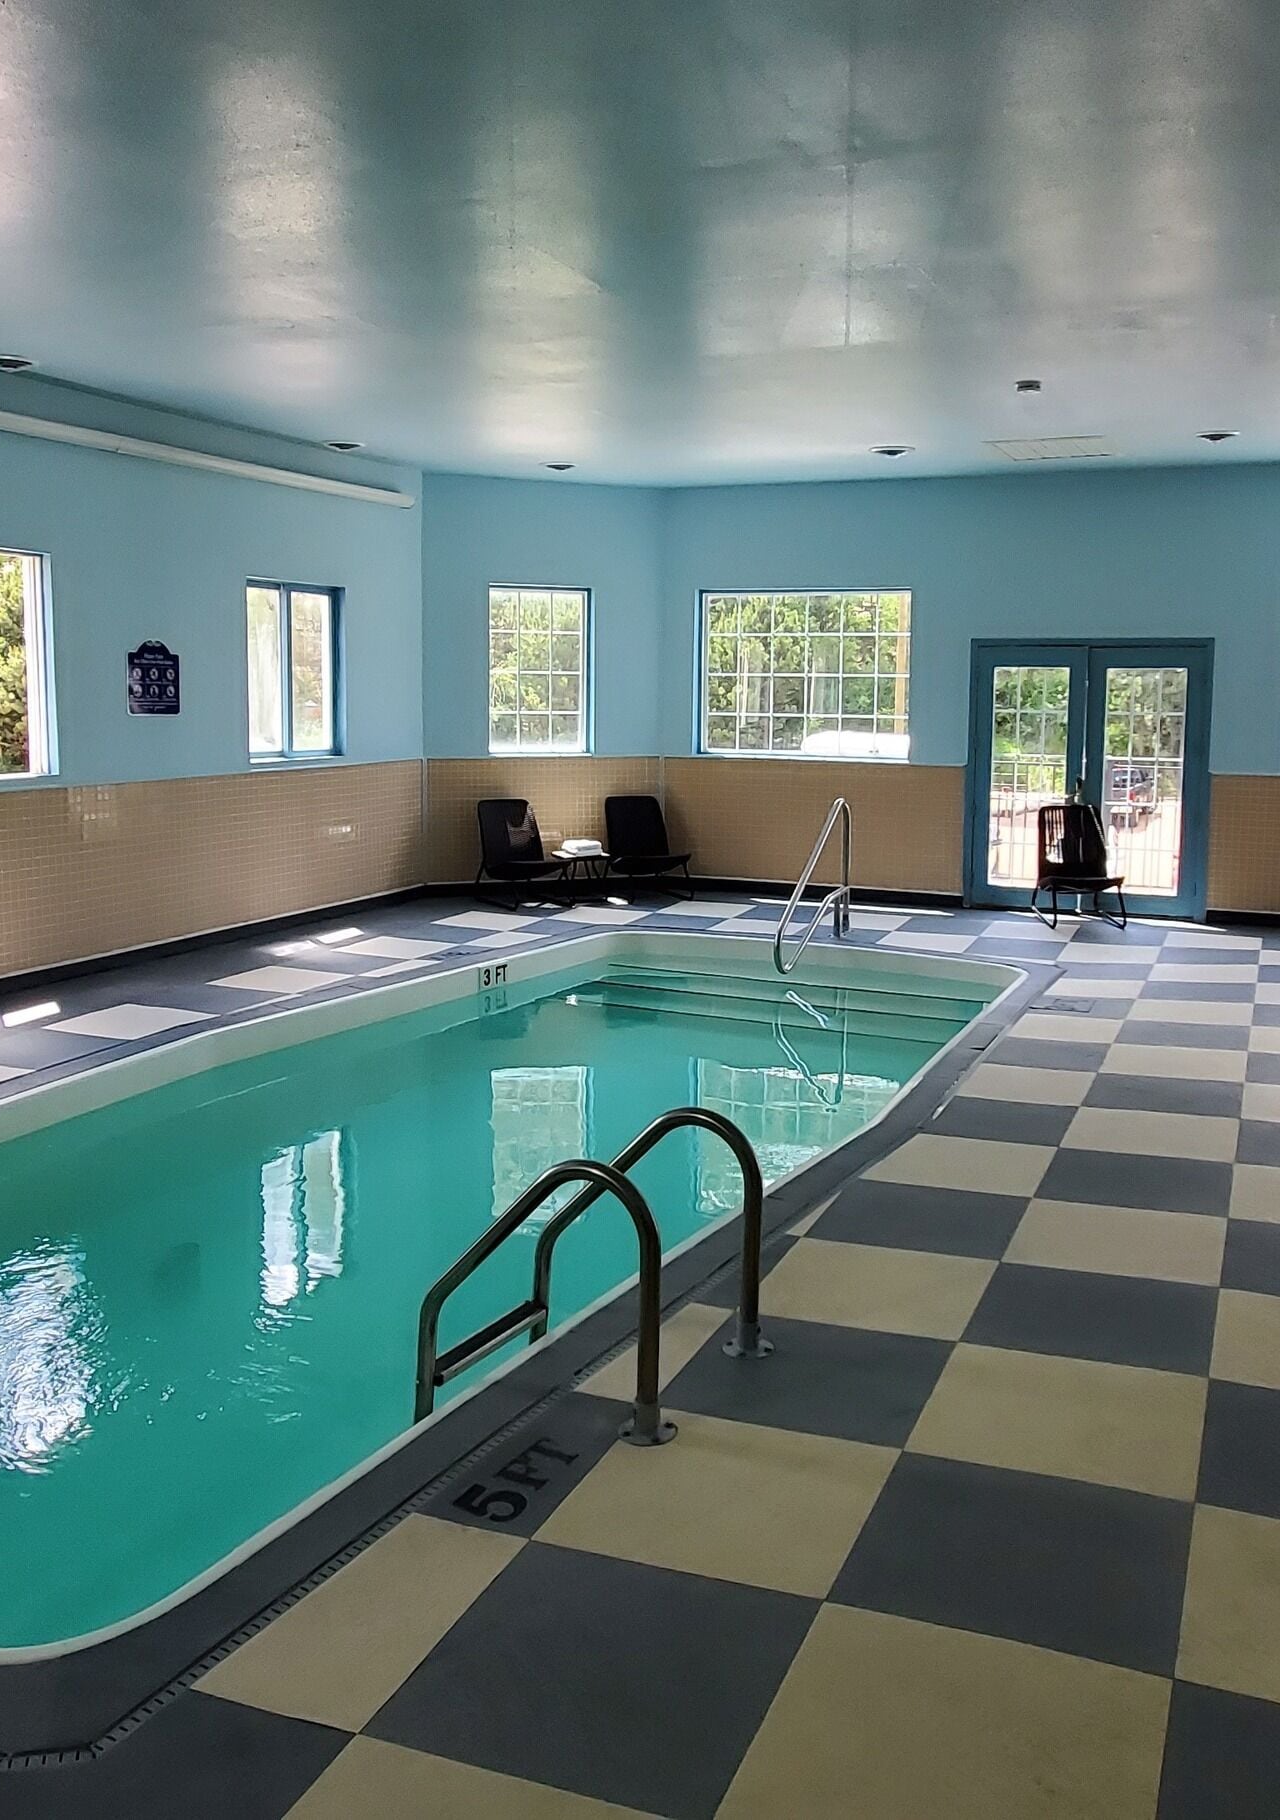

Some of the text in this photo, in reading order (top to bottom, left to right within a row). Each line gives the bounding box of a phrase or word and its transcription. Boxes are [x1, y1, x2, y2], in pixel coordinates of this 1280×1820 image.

[484, 964, 508, 986] 3 FT
[452, 1437, 580, 1523] 5 FT
